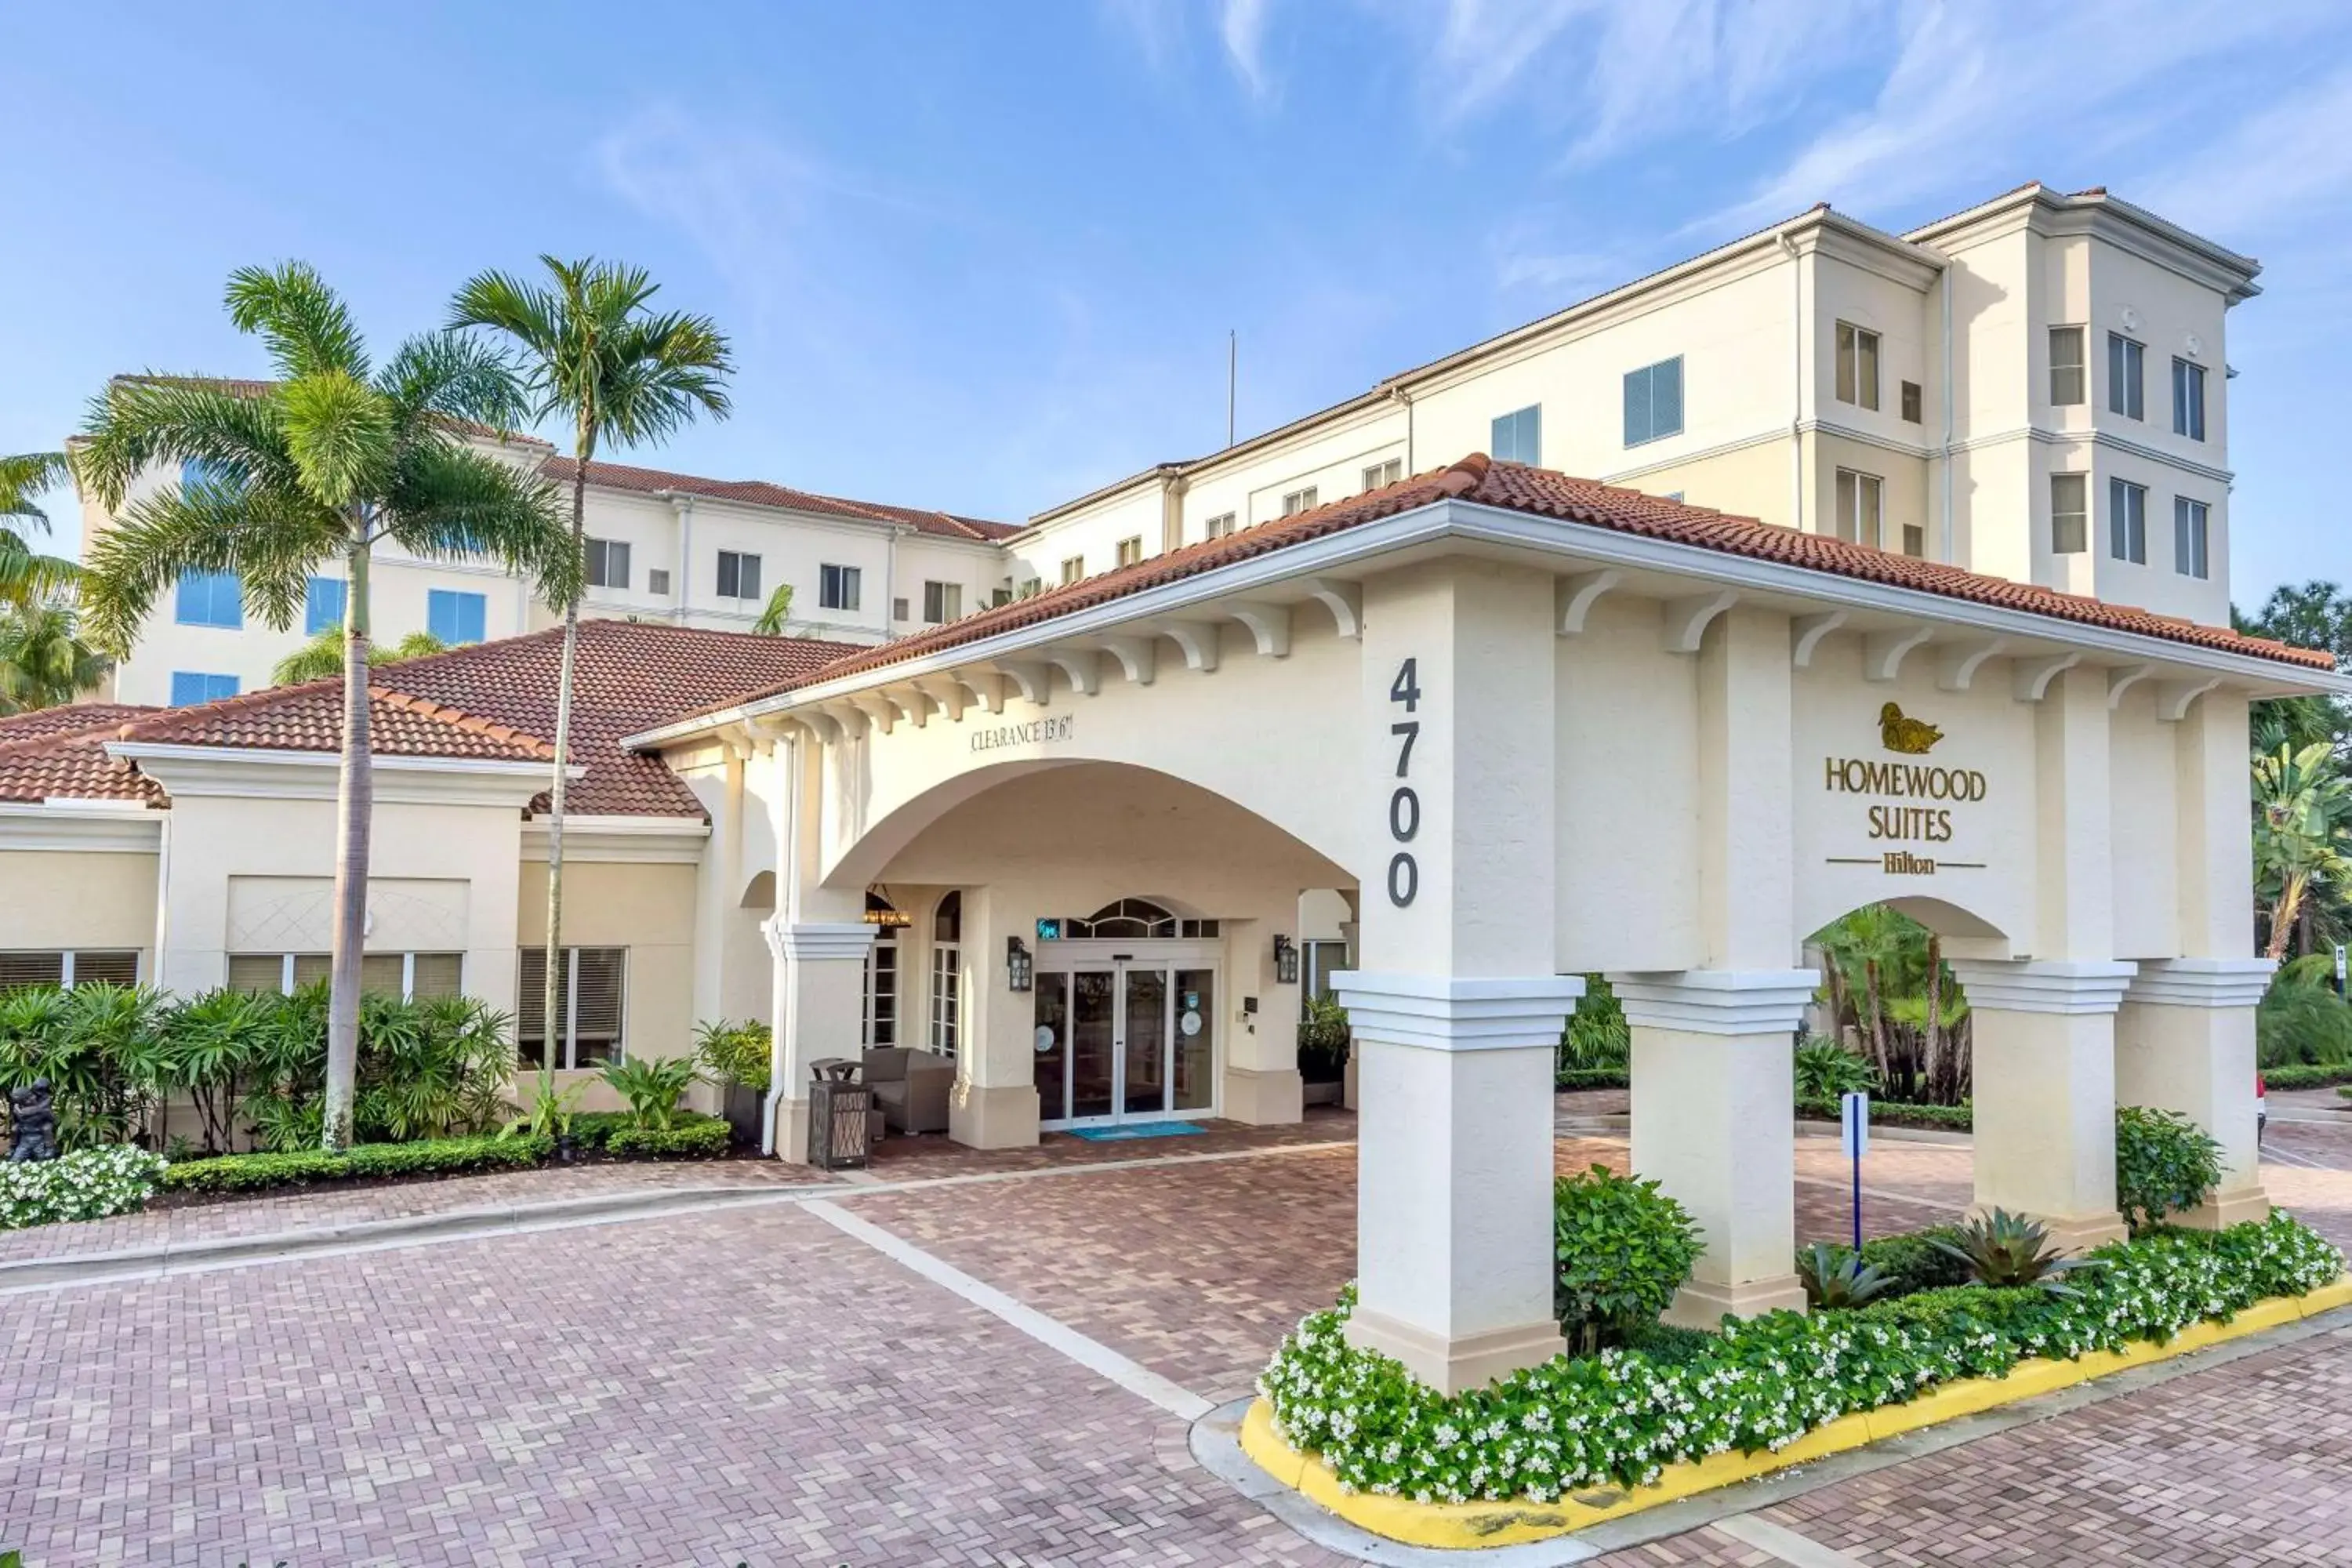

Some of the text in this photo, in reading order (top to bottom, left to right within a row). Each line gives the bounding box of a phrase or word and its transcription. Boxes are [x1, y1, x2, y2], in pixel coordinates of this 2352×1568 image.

[971, 721, 1040, 751] CLEARANCE
[1388, 658, 1421, 907] 4700
[1825, 757, 1987, 802] HOMEWOOD
[1868, 805, 1952, 842] SUITES
[1883, 851, 1936, 875] Hilton
